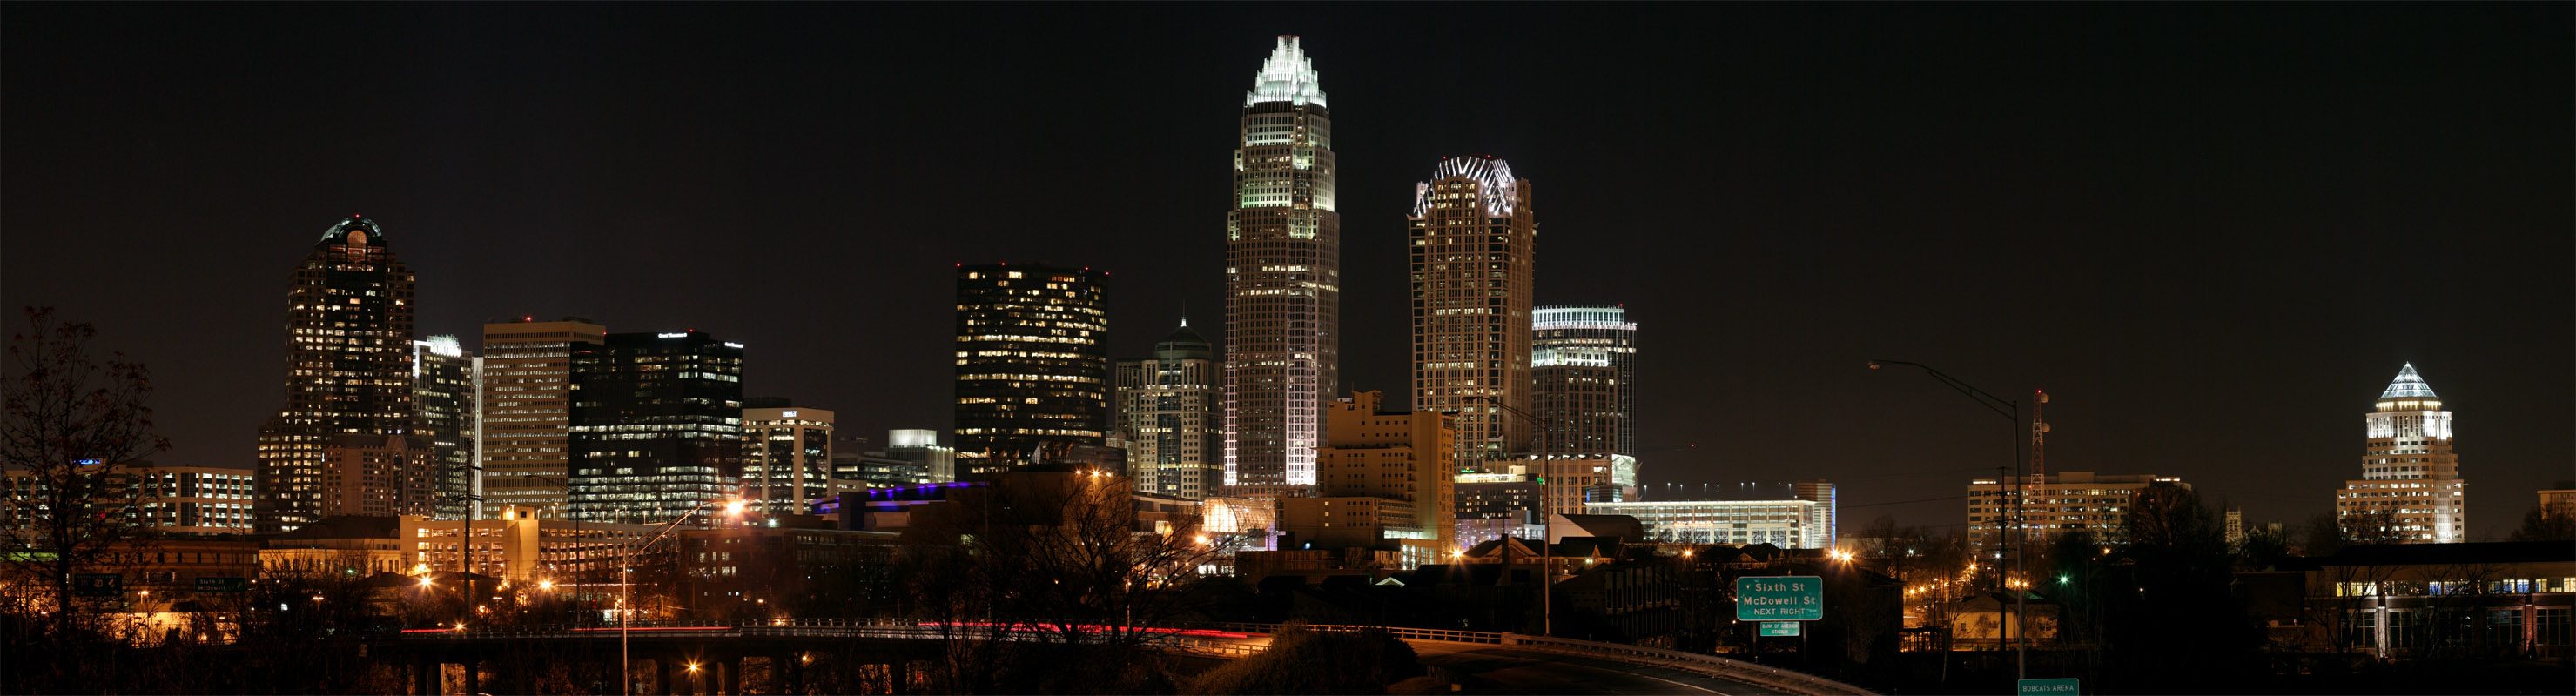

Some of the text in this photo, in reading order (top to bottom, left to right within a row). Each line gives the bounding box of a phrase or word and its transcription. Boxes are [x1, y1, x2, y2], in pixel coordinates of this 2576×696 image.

[1755, 583, 1805, 592] Sixth St
[1744, 596, 1816, 606] McDowell St
